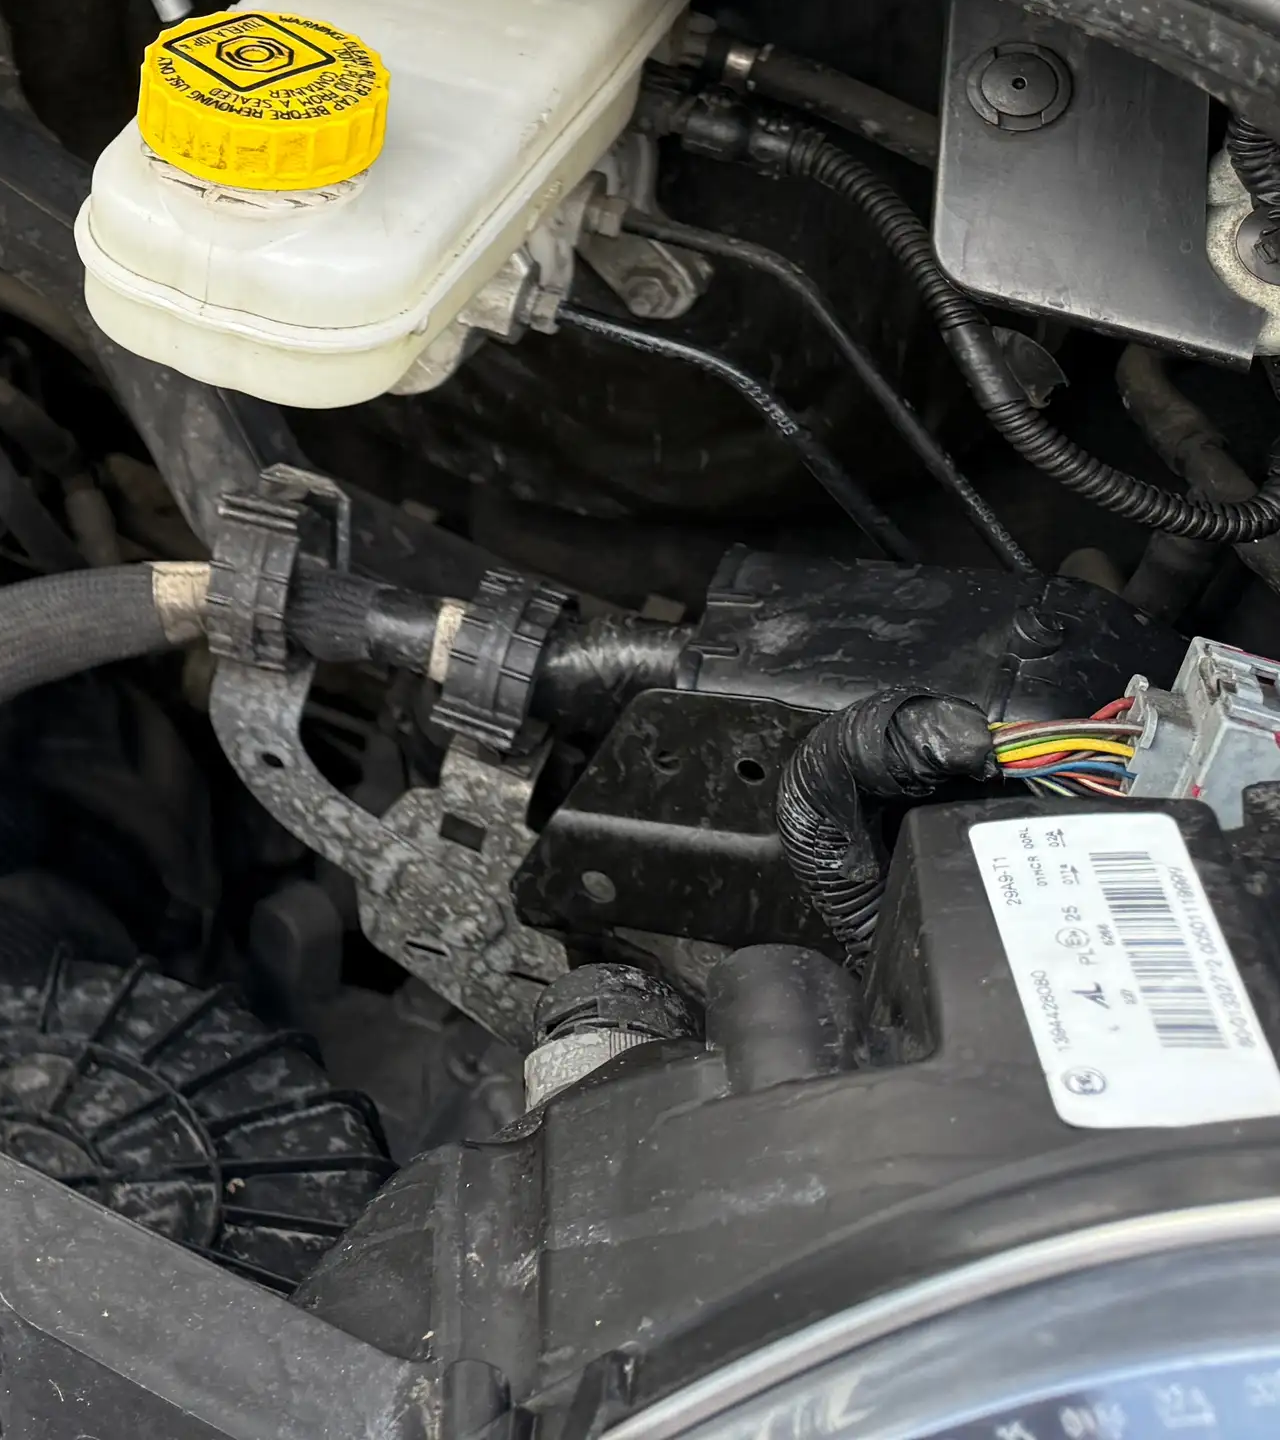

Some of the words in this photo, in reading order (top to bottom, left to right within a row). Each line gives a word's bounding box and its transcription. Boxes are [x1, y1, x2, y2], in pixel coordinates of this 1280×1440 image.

[165, 75, 191, 93] USE
[269, 71, 339, 99] CONTAINER
[186, 91, 263, 119] REMOVING
[209, 87, 273, 109] SEALED
[278, 99, 291, 109] A
[298, 89, 339, 107] FROM
[333, 95, 359, 111] CAP
[270, 105, 331, 120] BEFORE
[992, 856, 1022, 906] 29A9-T1
[1061, 905, 1082, 922] 25
